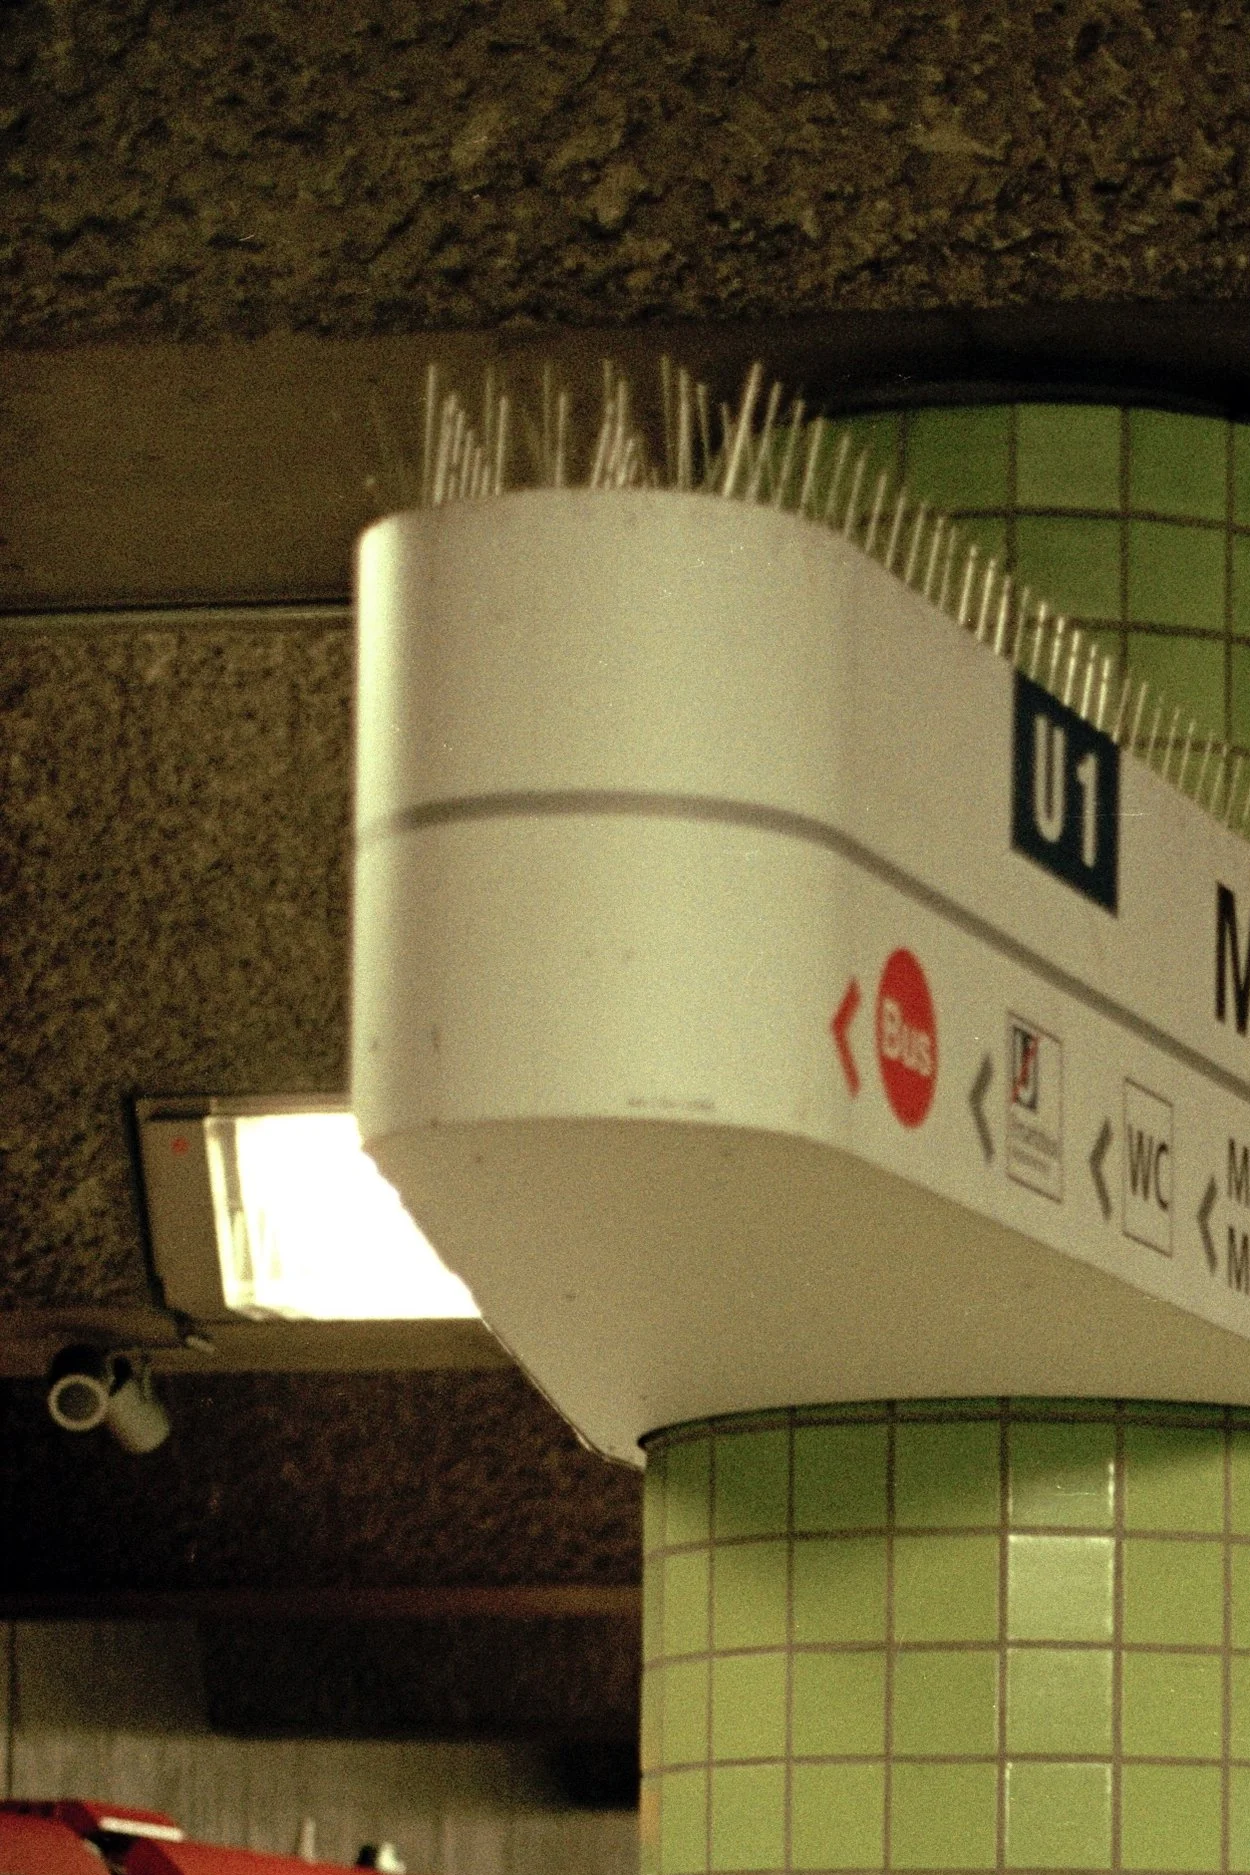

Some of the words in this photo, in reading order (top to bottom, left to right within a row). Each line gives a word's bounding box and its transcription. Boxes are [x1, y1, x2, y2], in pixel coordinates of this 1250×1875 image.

[1032, 713, 1099, 869] U1
[882, 996, 933, 1078] Bus
[1127, 1123, 1169, 1212] WC
